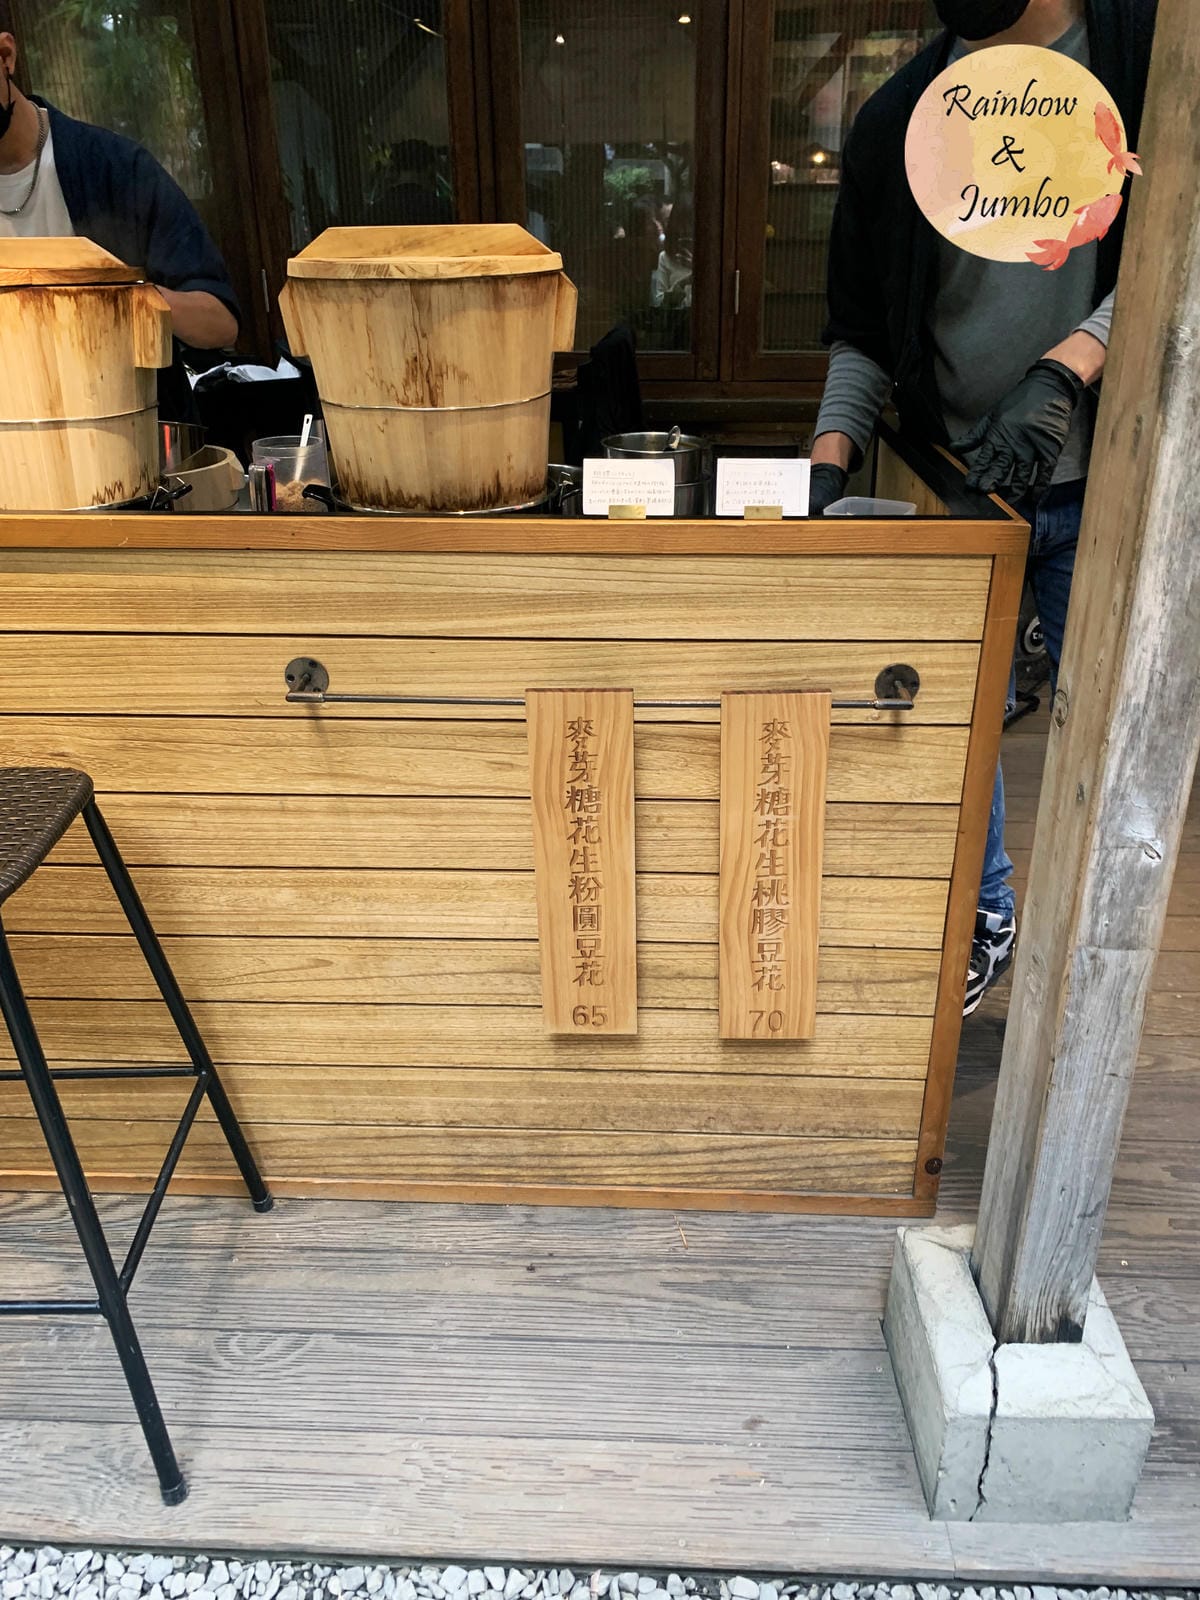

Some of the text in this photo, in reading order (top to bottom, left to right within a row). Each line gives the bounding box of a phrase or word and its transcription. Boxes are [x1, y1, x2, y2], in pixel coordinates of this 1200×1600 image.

[564, 716, 606, 987] 麥芽糖花生粉圓豆花
[751, 718, 793, 992] 麥芽糖花生桃膠豆花
[572, 1004, 608, 1027] 65
[749, 1009, 785, 1033] 70
